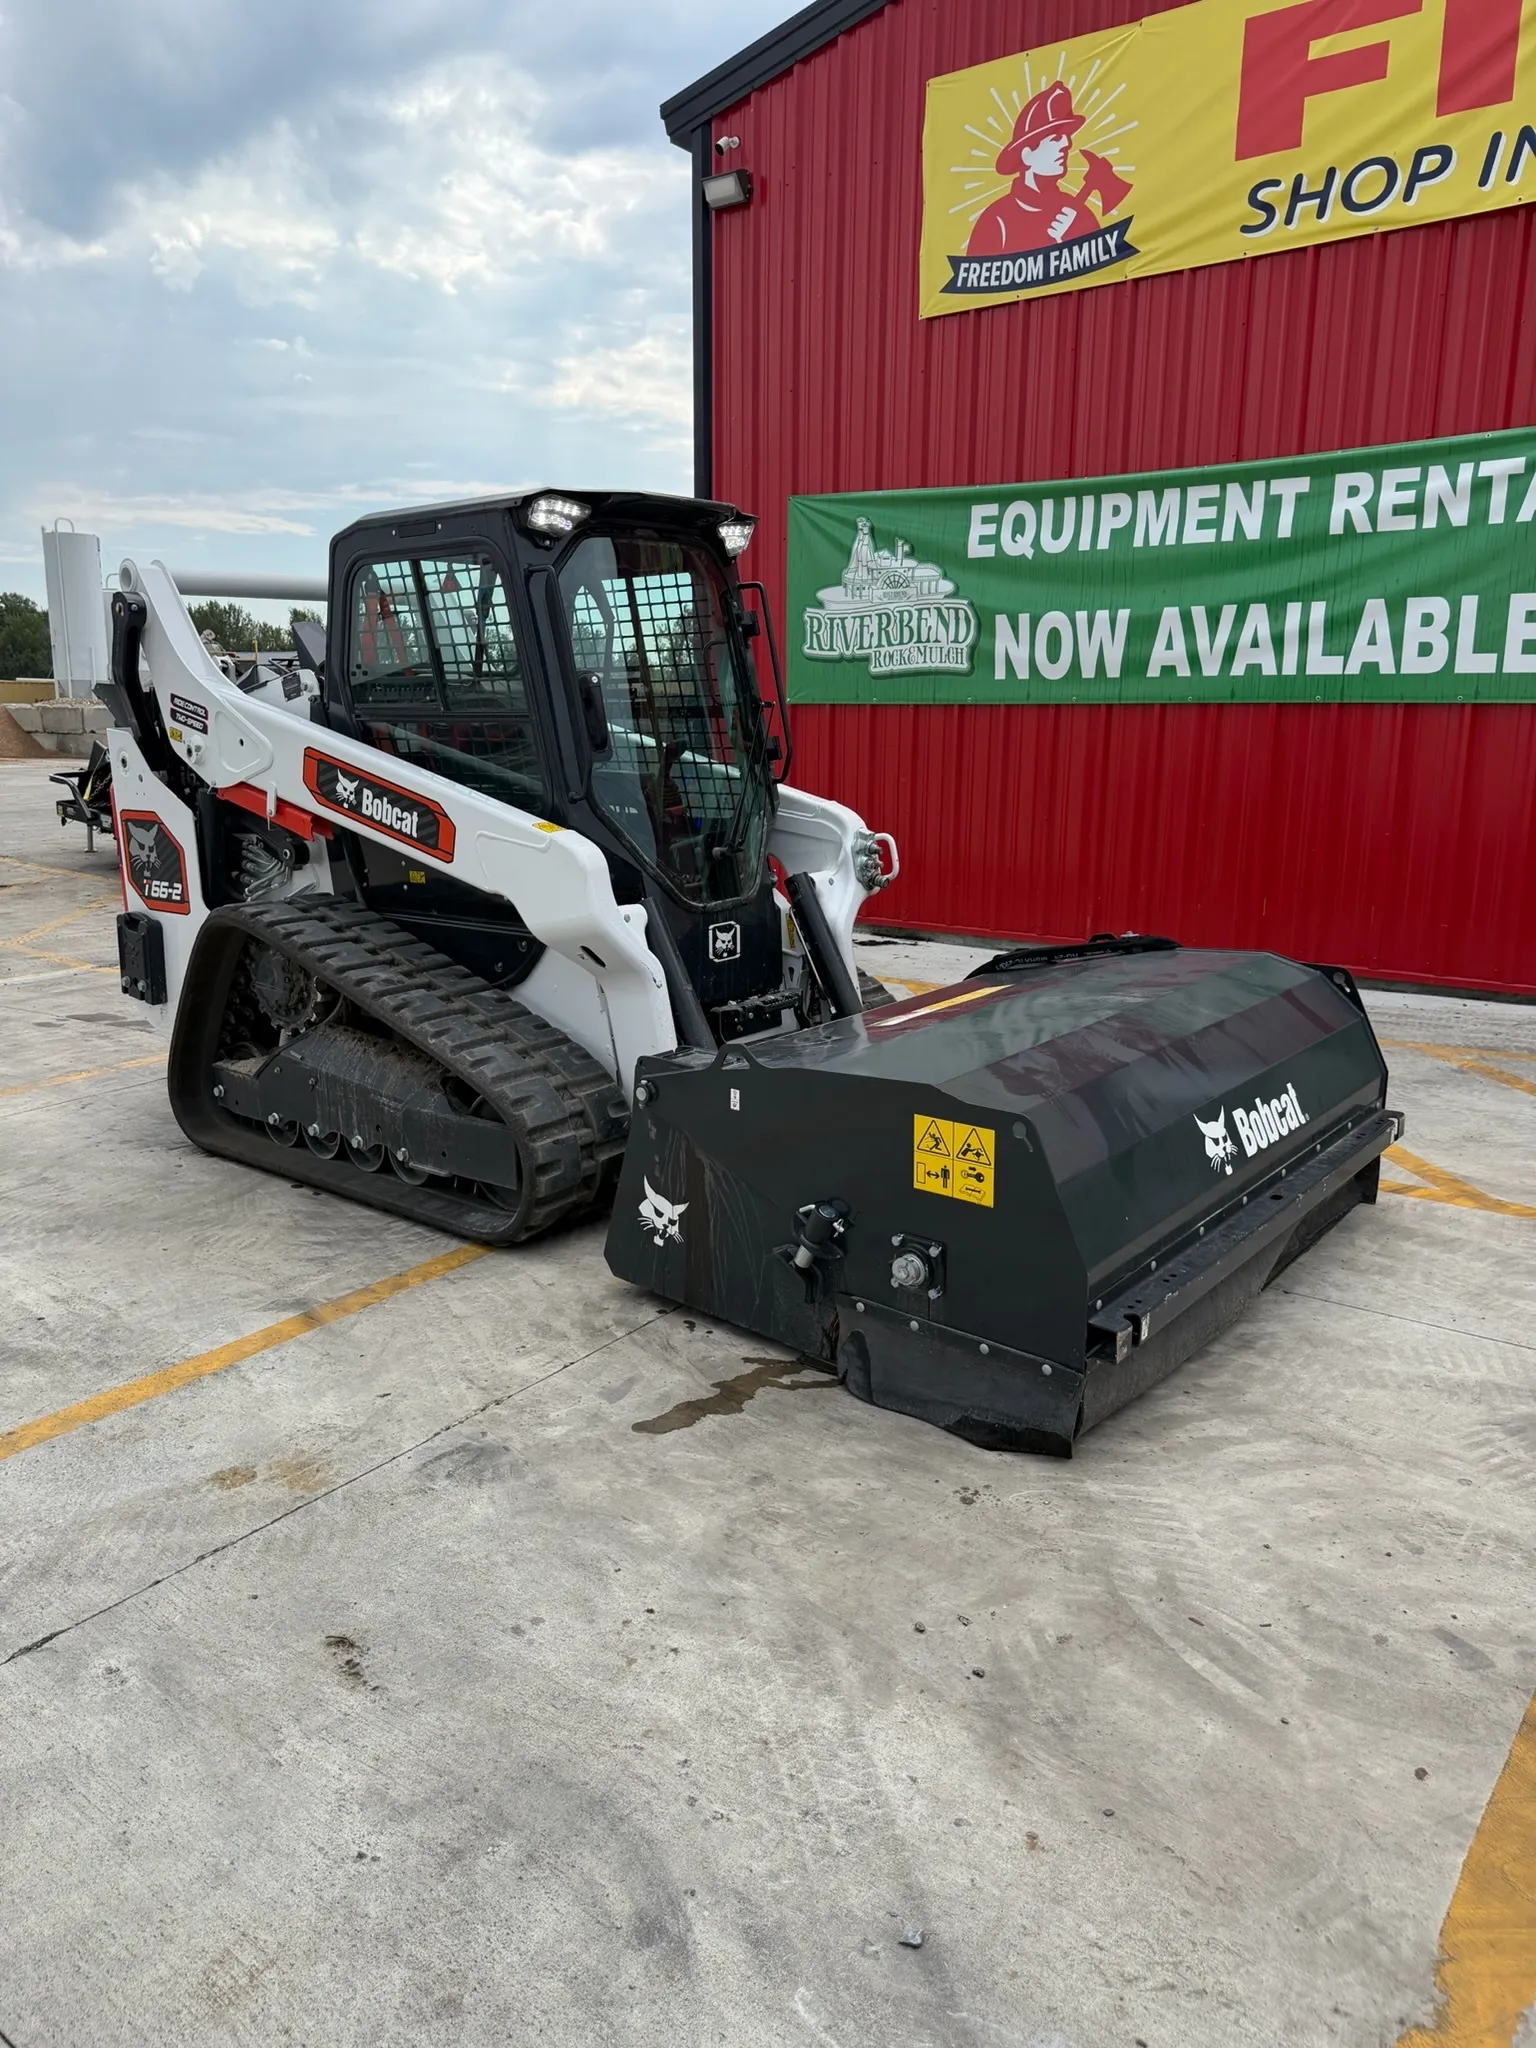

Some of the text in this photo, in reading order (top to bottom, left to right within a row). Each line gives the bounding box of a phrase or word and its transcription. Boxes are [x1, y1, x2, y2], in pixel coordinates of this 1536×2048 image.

[1239, 144, 1454, 235] SHOP
[956, 230, 1119, 287] FREEDOM FAMILY
[967, 456, 1536, 560] EQUIPMENT RENT
[806, 605, 973, 651] RIVERBEND
[994, 592, 1536, 680] NOW AVAILABLE
[175, 712, 204, 730] TWO-SPEED
[184, 701, 207, 717] CONTROL
[361, 787, 419, 838] Bobcat
[1231, 1082, 1307, 1158] Bobcat
